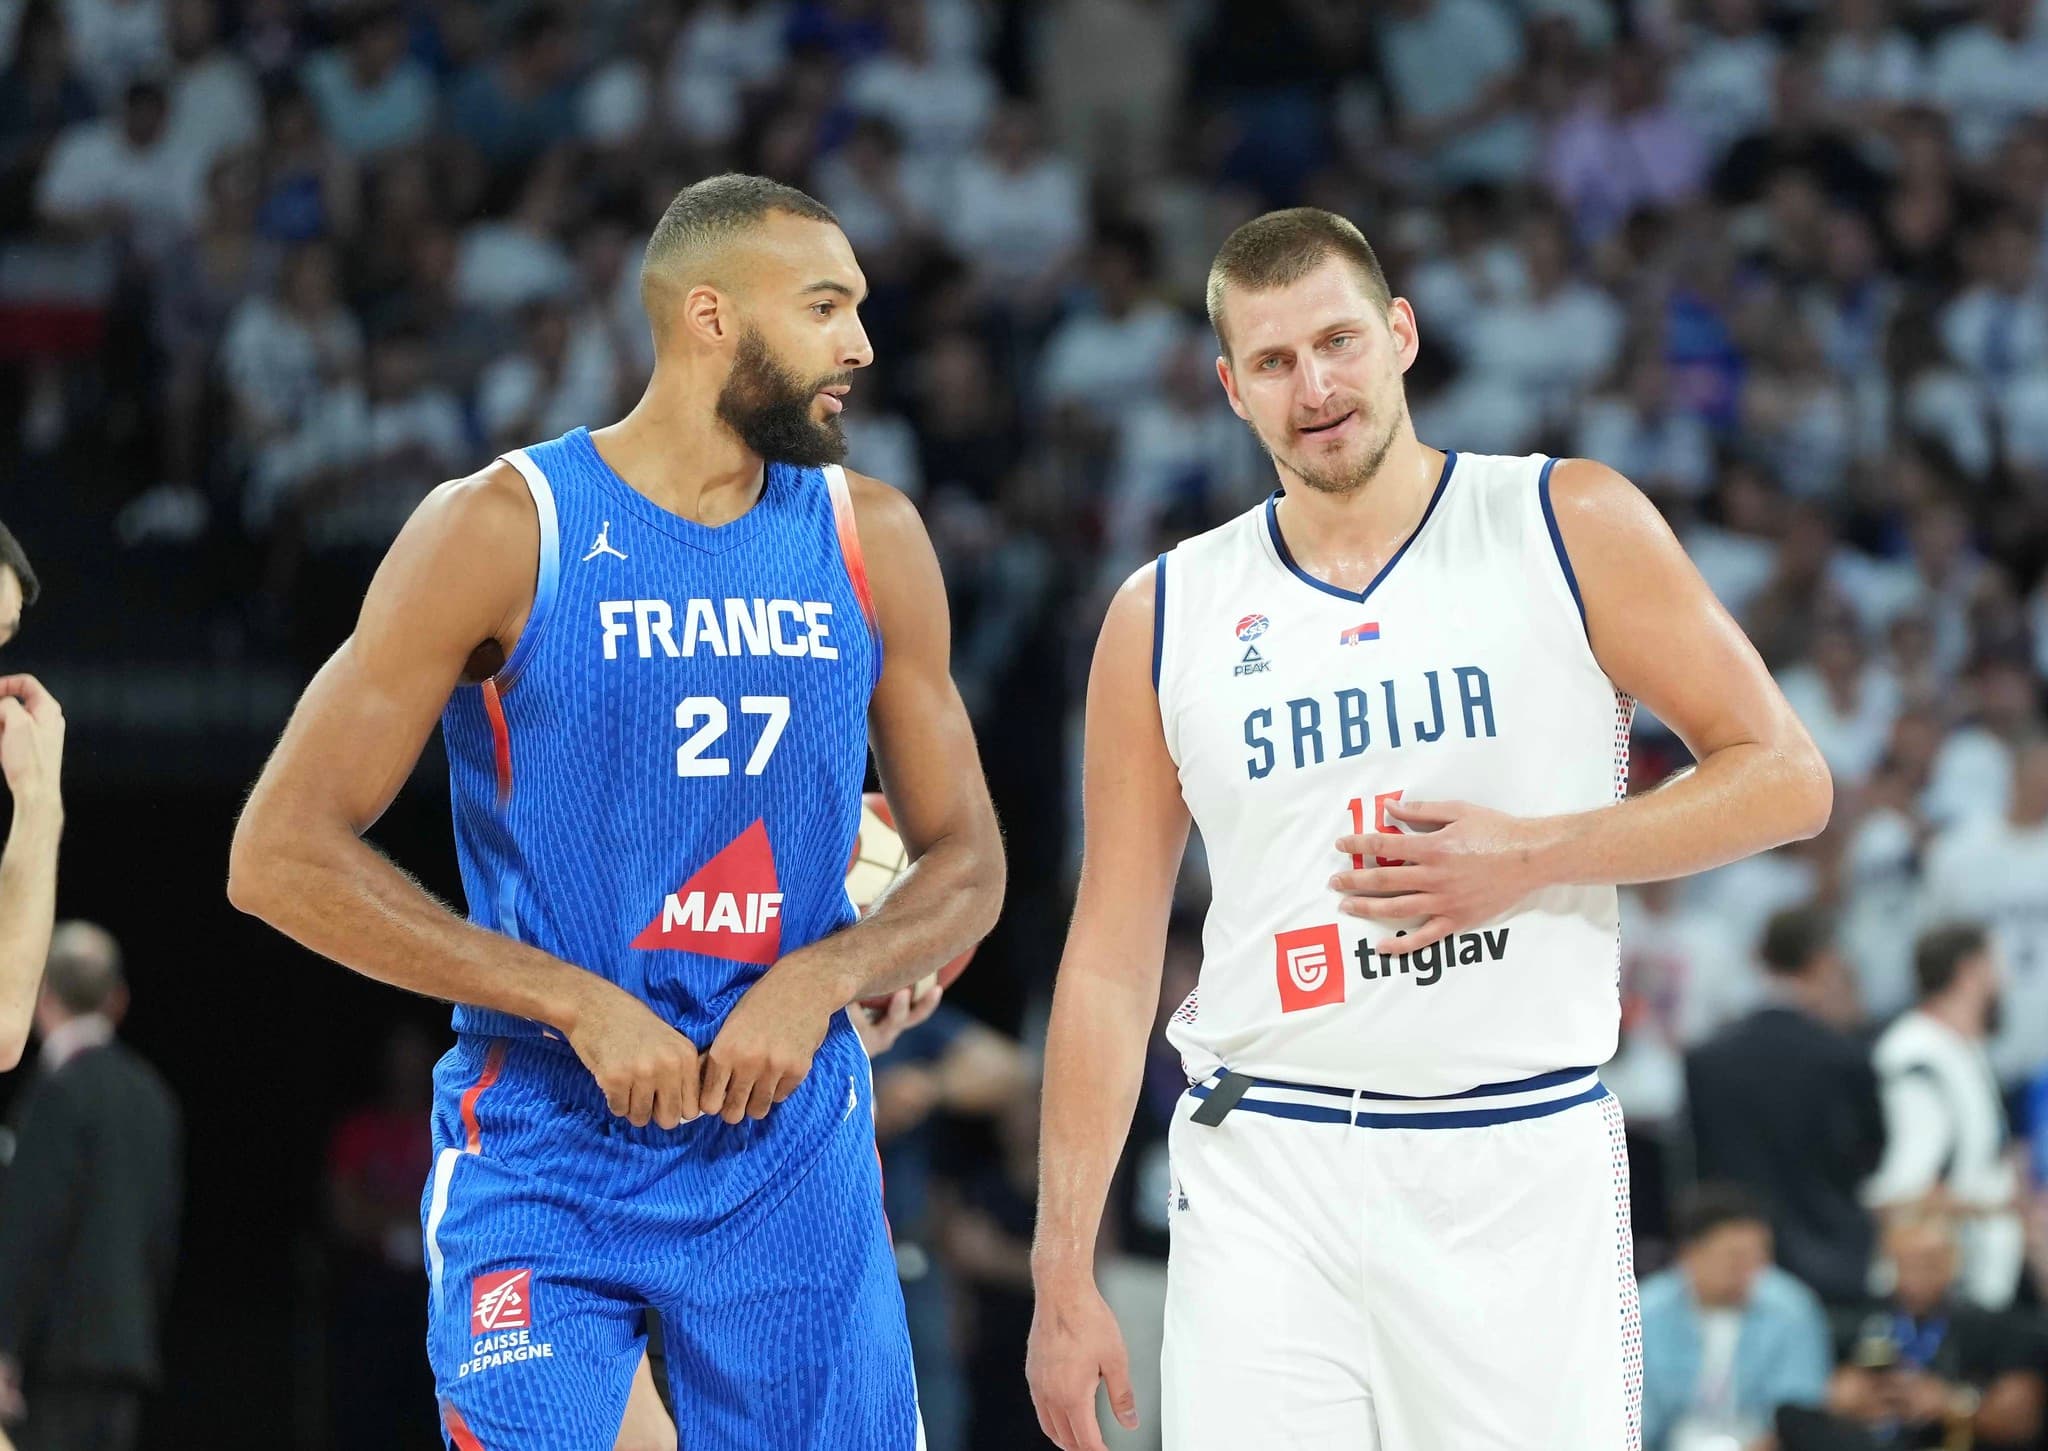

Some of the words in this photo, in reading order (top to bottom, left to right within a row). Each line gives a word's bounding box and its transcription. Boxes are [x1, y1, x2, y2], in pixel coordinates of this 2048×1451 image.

[599, 598, 839, 660] FRANCE
[1233, 660, 1272, 677] PEAK
[675, 696, 790, 777] 27
[1243, 665, 1497, 781] SRBIJA
[1347, 790, 1406, 870] 15
[662, 891, 784, 934] MAIF
[458, 1343, 554, 1378] D'EPARGNE
[473, 1329, 530, 1356] CAISSE
